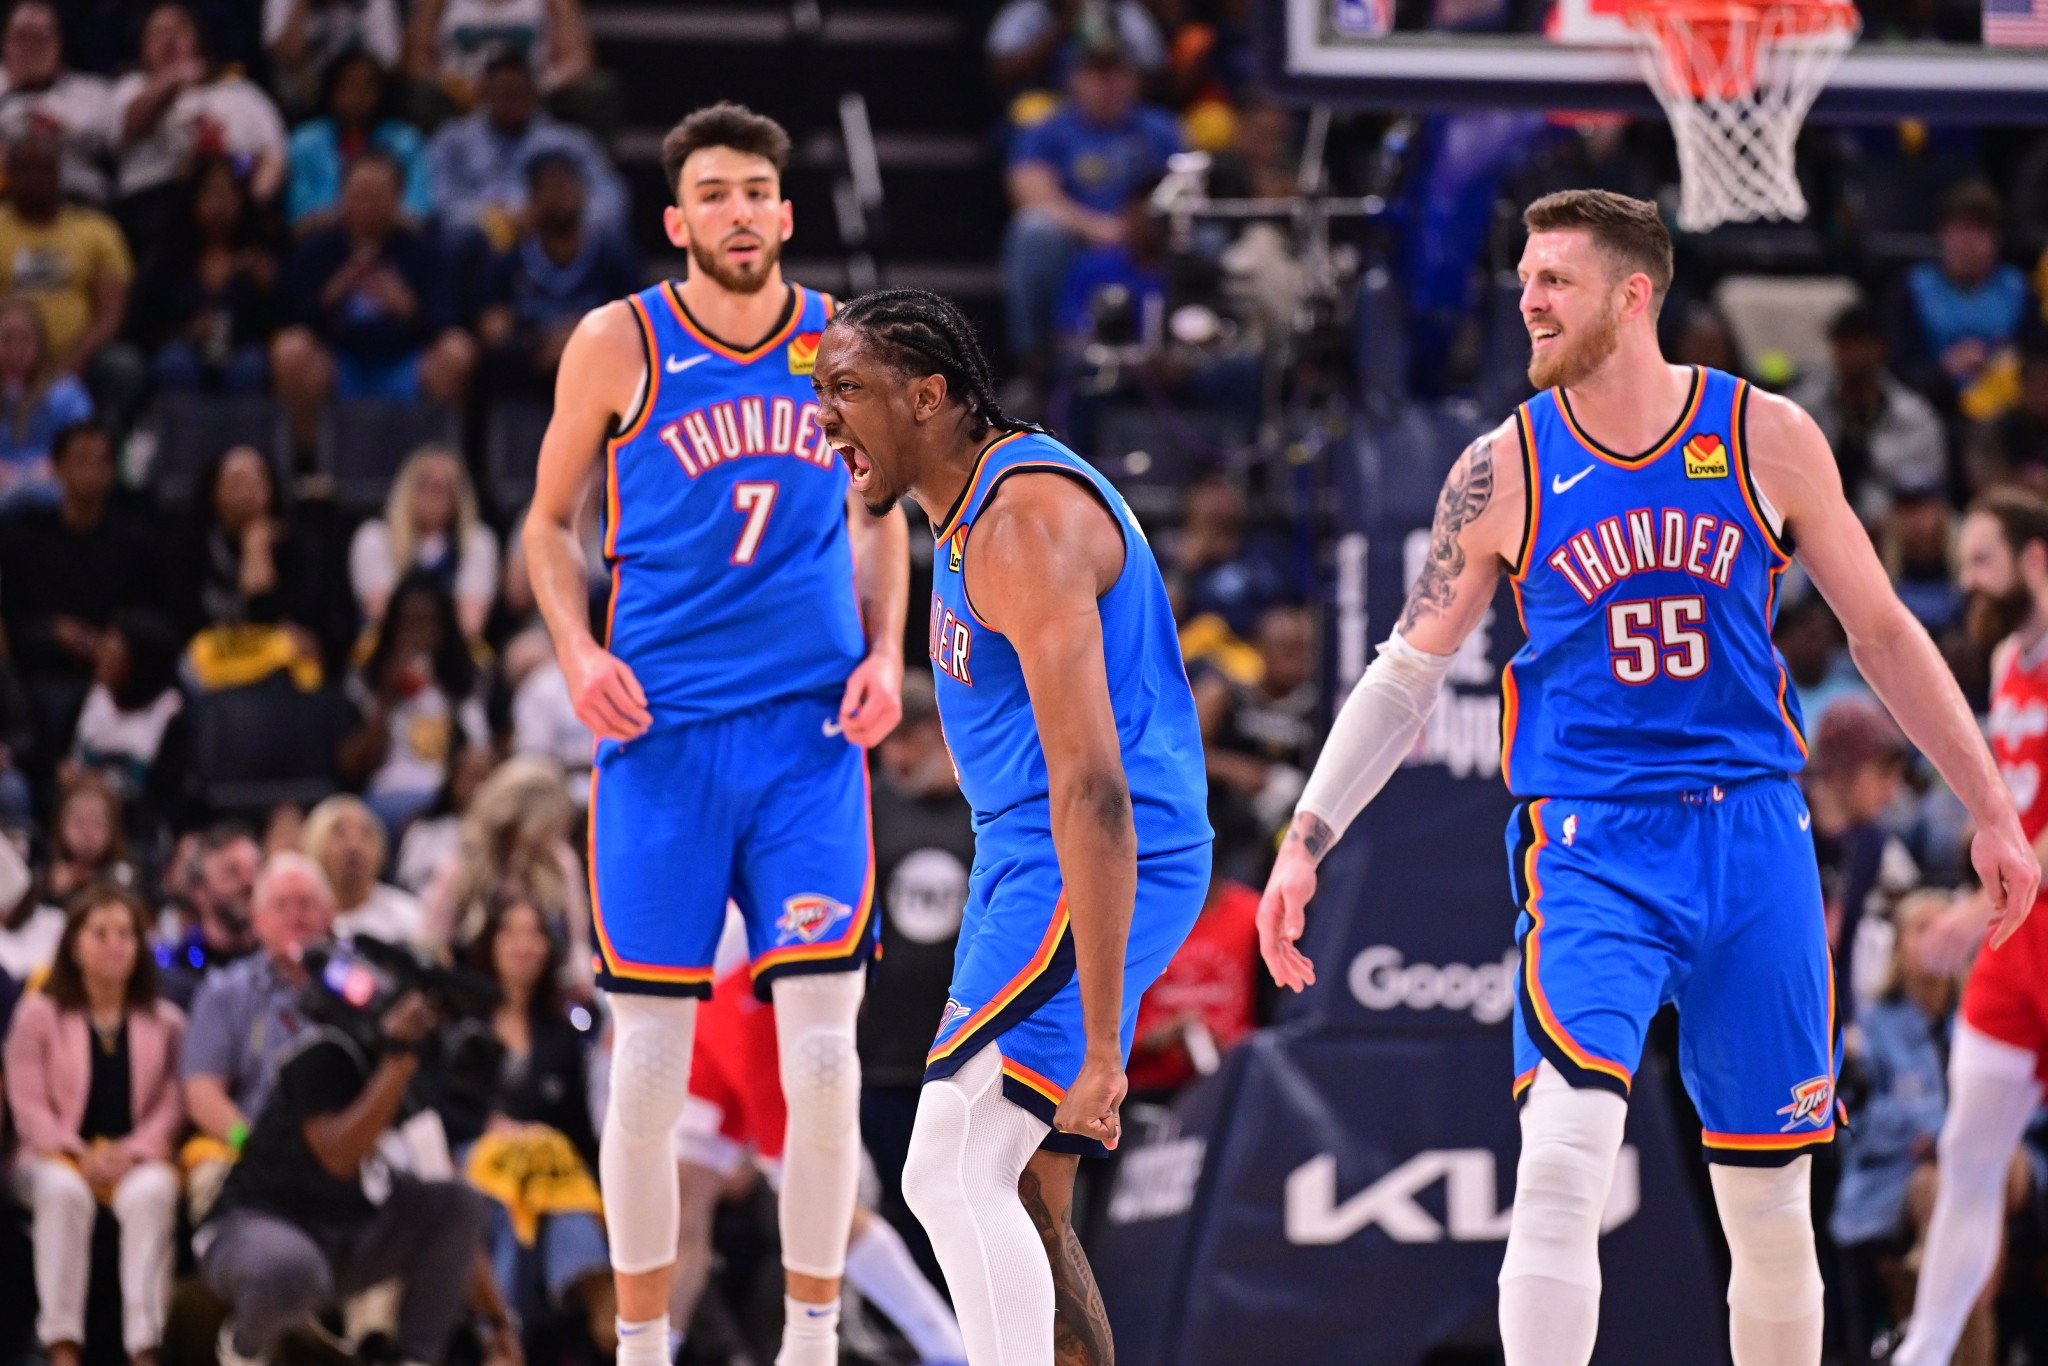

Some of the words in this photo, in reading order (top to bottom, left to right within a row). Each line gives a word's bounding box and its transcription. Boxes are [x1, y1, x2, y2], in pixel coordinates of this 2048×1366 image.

[729, 481, 780, 566] 7
[1548, 507, 1744, 605] THUNDER
[930, 589, 973, 688] DER
[1606, 595, 1710, 686] 55
[1350, 946, 1520, 1023] Goog
